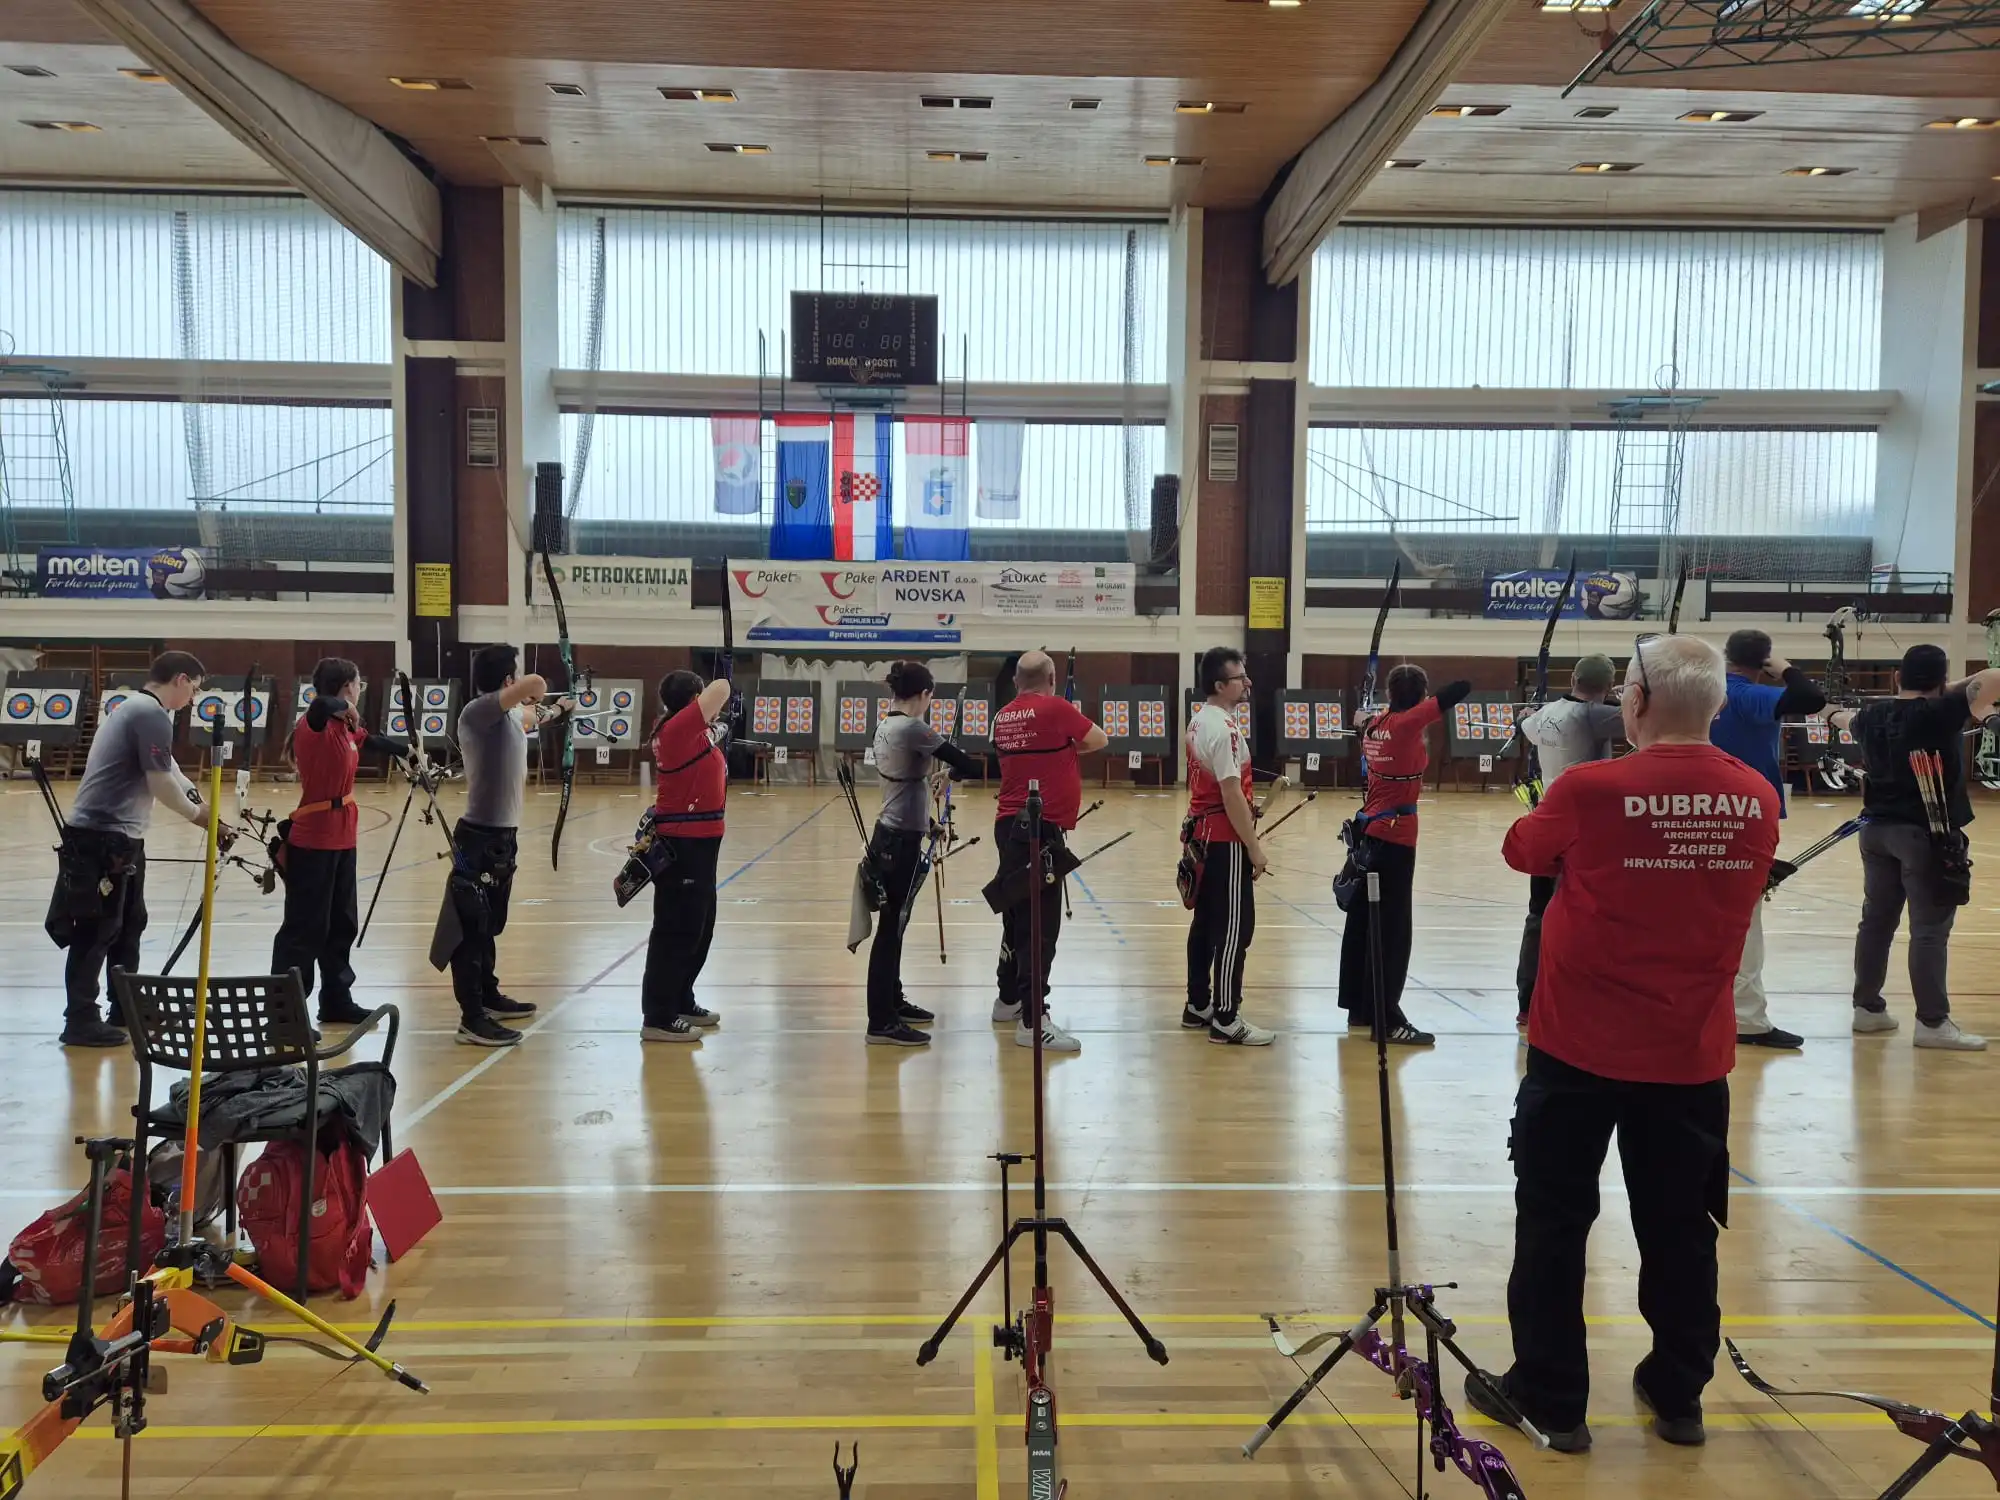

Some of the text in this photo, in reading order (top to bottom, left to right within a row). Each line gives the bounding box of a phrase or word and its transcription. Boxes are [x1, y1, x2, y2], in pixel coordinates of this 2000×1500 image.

[48, 554, 139, 576] molten
[572, 566, 688, 584] PETROKEMIJA
[845, 572, 875, 584] Pake
[64, 578, 82, 588] the
[84, 578, 108, 588] real
[108, 581, 138, 592] game
[582, 586, 678, 596] KUTINA
[895, 588, 966, 602] NOVSKA
[1505, 600, 1522, 610] the
[1524, 600, 1547, 610] real
[777, 750, 785, 758] 12
[1131, 755, 1140, 764] 16
[1309, 757, 1318, 766] 18
[1481, 758, 1490, 767] 20
[1624, 793, 1762, 819] DUBRAVA
[1651, 819, 1745, 830] STRELIČARSKI KLUB
[1663, 832, 1734, 840] ARCHERY CLUB
[1668, 844, 1727, 856] ZAGREB
[1624, 858, 1696, 869] HRVATSKA
[1708, 859, 1754, 870] CROATIA
